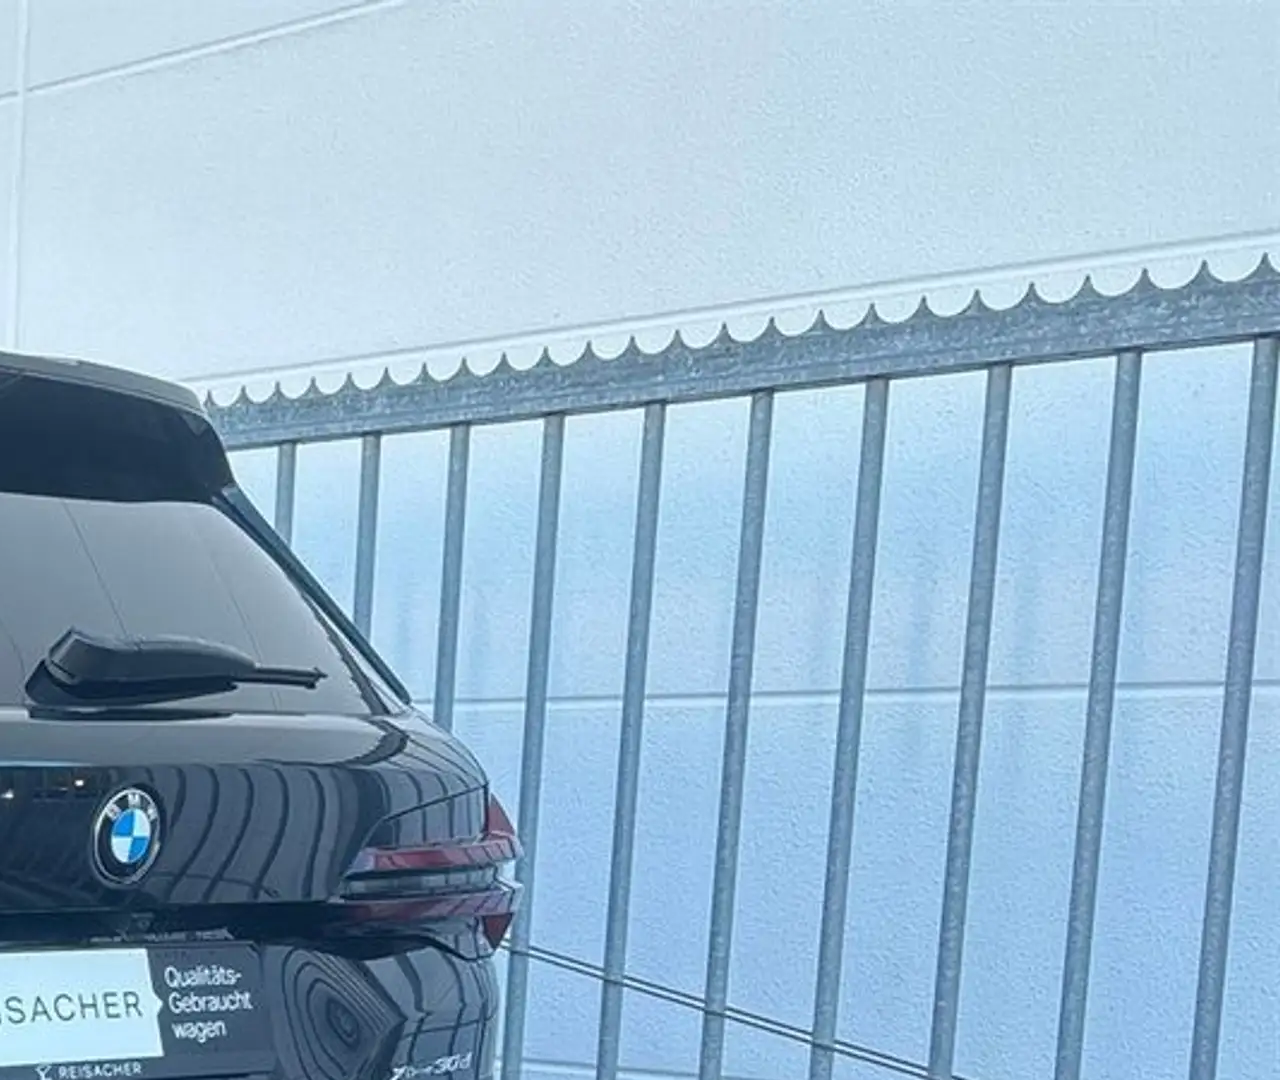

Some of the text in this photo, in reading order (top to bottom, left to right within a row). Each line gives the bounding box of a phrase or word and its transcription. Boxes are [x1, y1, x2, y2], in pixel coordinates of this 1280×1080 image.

[105, 793, 158, 821] BMW
[164, 964, 242, 988] Qualitäts-
[168, 990, 253, 1014] Gebraucht
[171, 1020, 228, 1043] wagen
[58, 1060, 142, 1080] REISACHER
